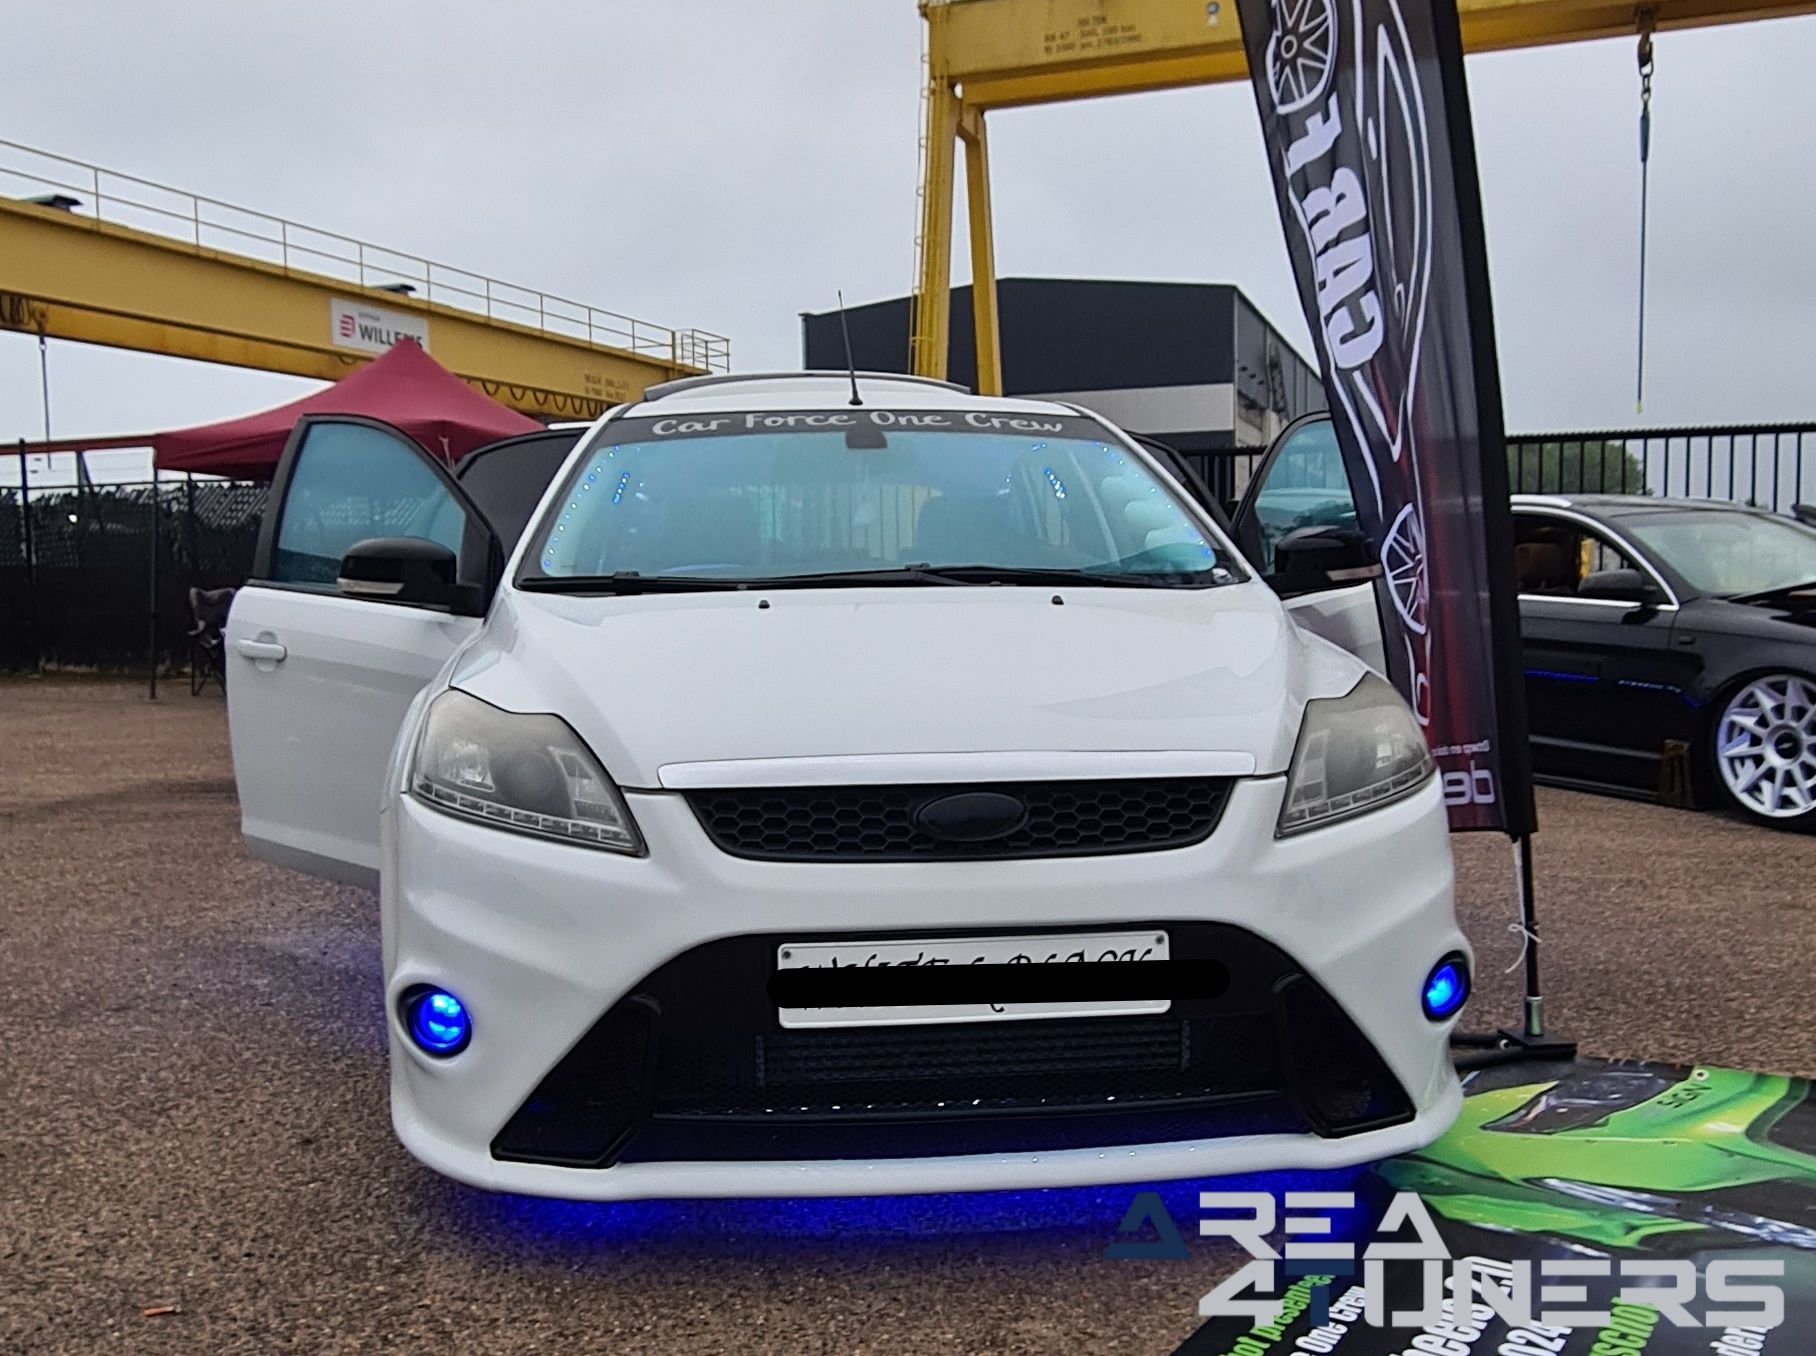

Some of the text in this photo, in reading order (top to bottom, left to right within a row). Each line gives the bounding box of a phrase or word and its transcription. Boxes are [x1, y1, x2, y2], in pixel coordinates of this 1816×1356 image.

[652, 411, 1063, 435] Car Force One Crew
